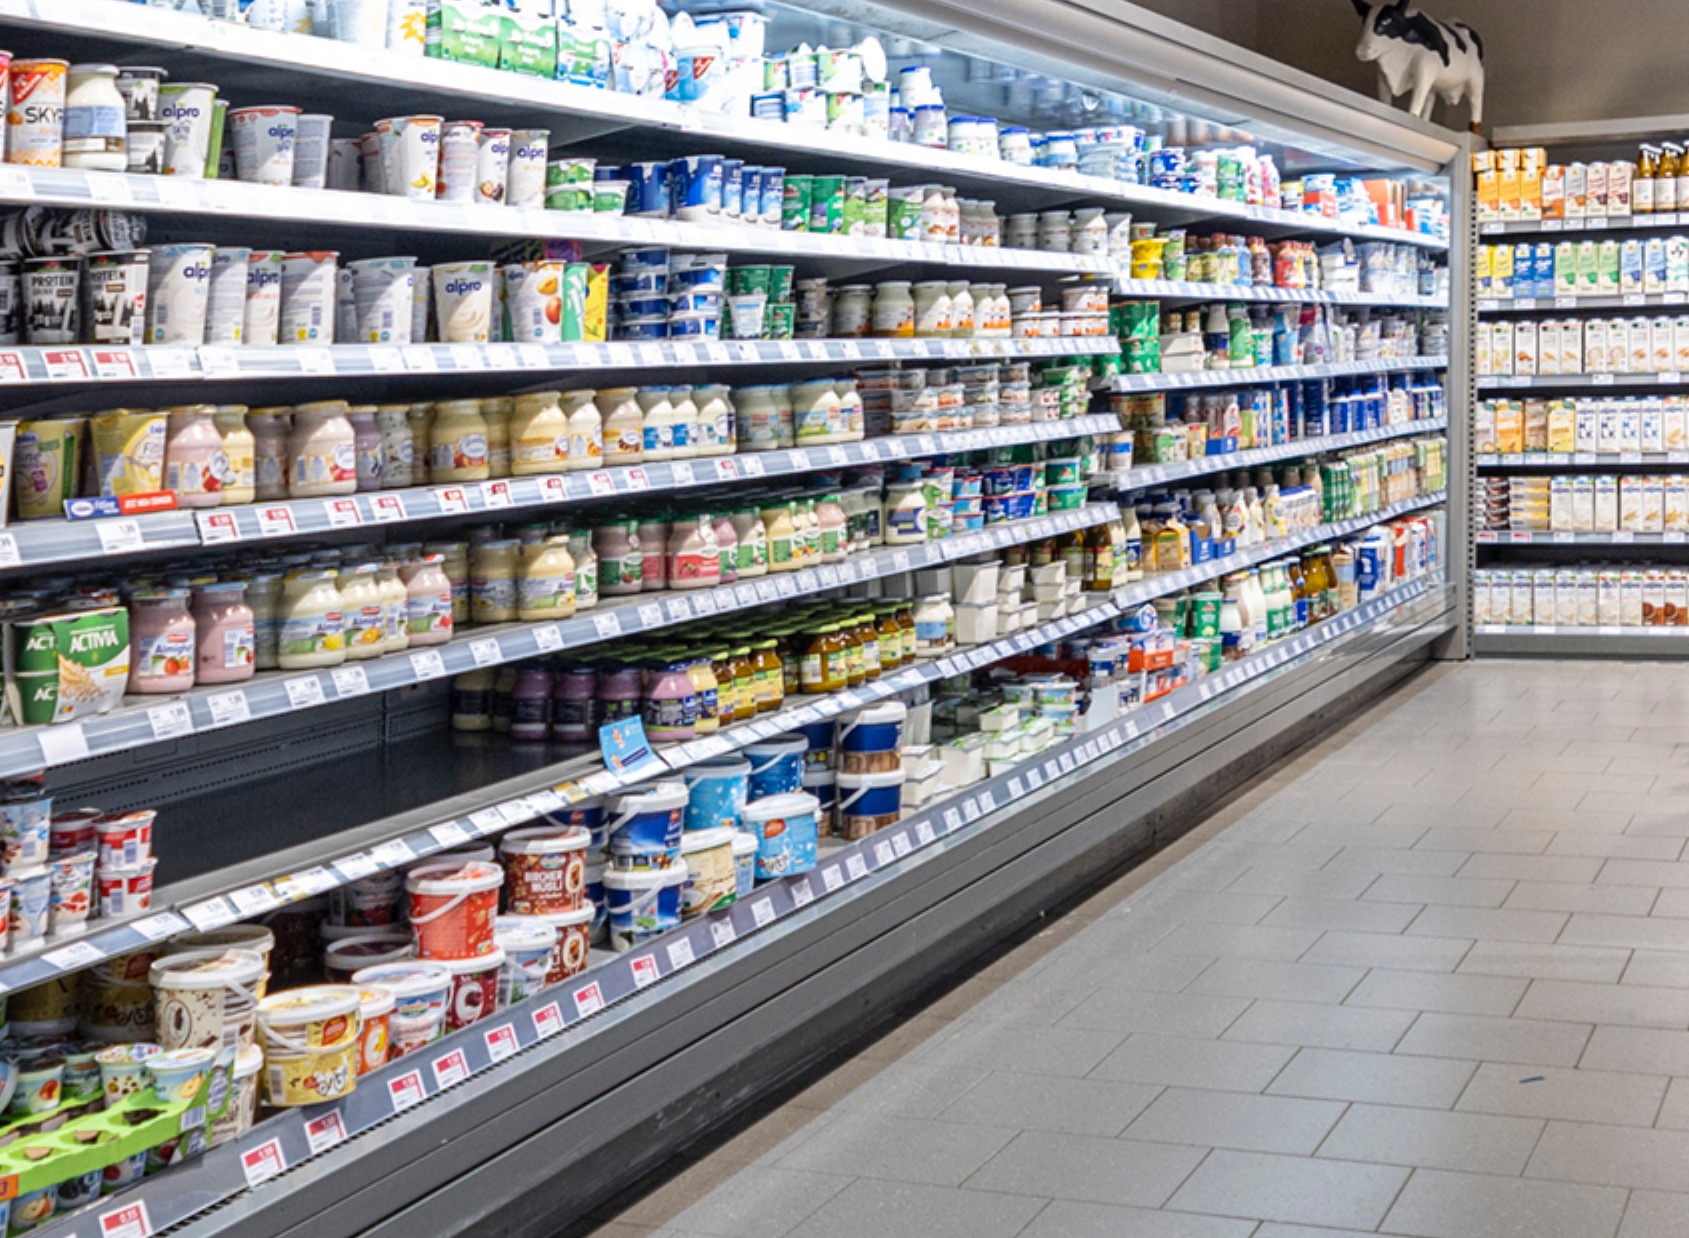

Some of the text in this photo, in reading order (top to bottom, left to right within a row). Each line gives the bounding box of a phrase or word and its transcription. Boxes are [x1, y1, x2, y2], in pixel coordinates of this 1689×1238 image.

[162, 103, 200, 120] alpro
[420, 129, 439, 144] alp
[491, 141, 508, 156] alp
[183, 261, 209, 282] alp
[445, 278, 482, 296] alpro
[69, 630, 119, 654] ACTIVIA
